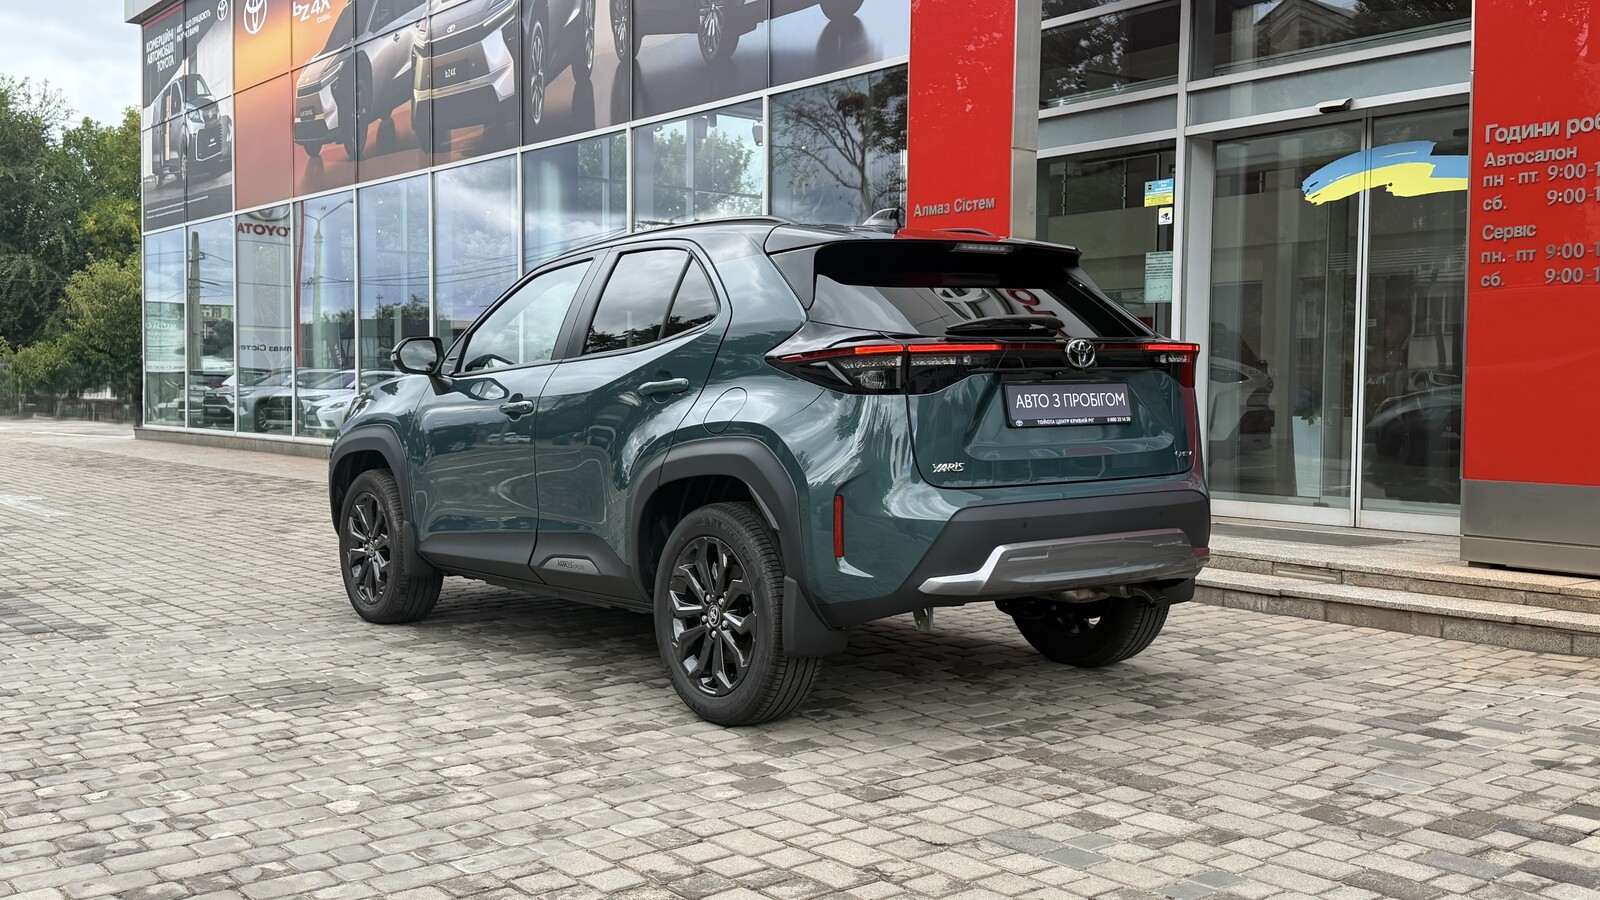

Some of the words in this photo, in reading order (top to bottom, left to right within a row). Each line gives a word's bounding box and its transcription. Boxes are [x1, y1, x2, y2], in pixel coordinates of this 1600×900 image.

[147, 41, 174, 66] АВТОМОБІЛІ
[157, 54, 175, 73] TOYOTA
[1485, 121, 1560, 144] Години
[1483, 146, 1578, 168] Автосалон
[1483, 174, 1504, 188] пн
[913, 203, 951, 218] Алмаз
[953, 196, 996, 213] Сістем
[1482, 195, 1507, 211] сб.
[1481, 224, 1537, 242] Сервіс
[1480, 271, 1505, 287] сб.
[1016, 394, 1050, 408] АВТО
[1063, 392, 1126, 407] ПРОБІГОМ
[1037, 418, 1056, 426] ТОЙОТА
[1056, 418, 1069, 426] ЦЕНТР
[932, 461, 965, 473] YARIS
